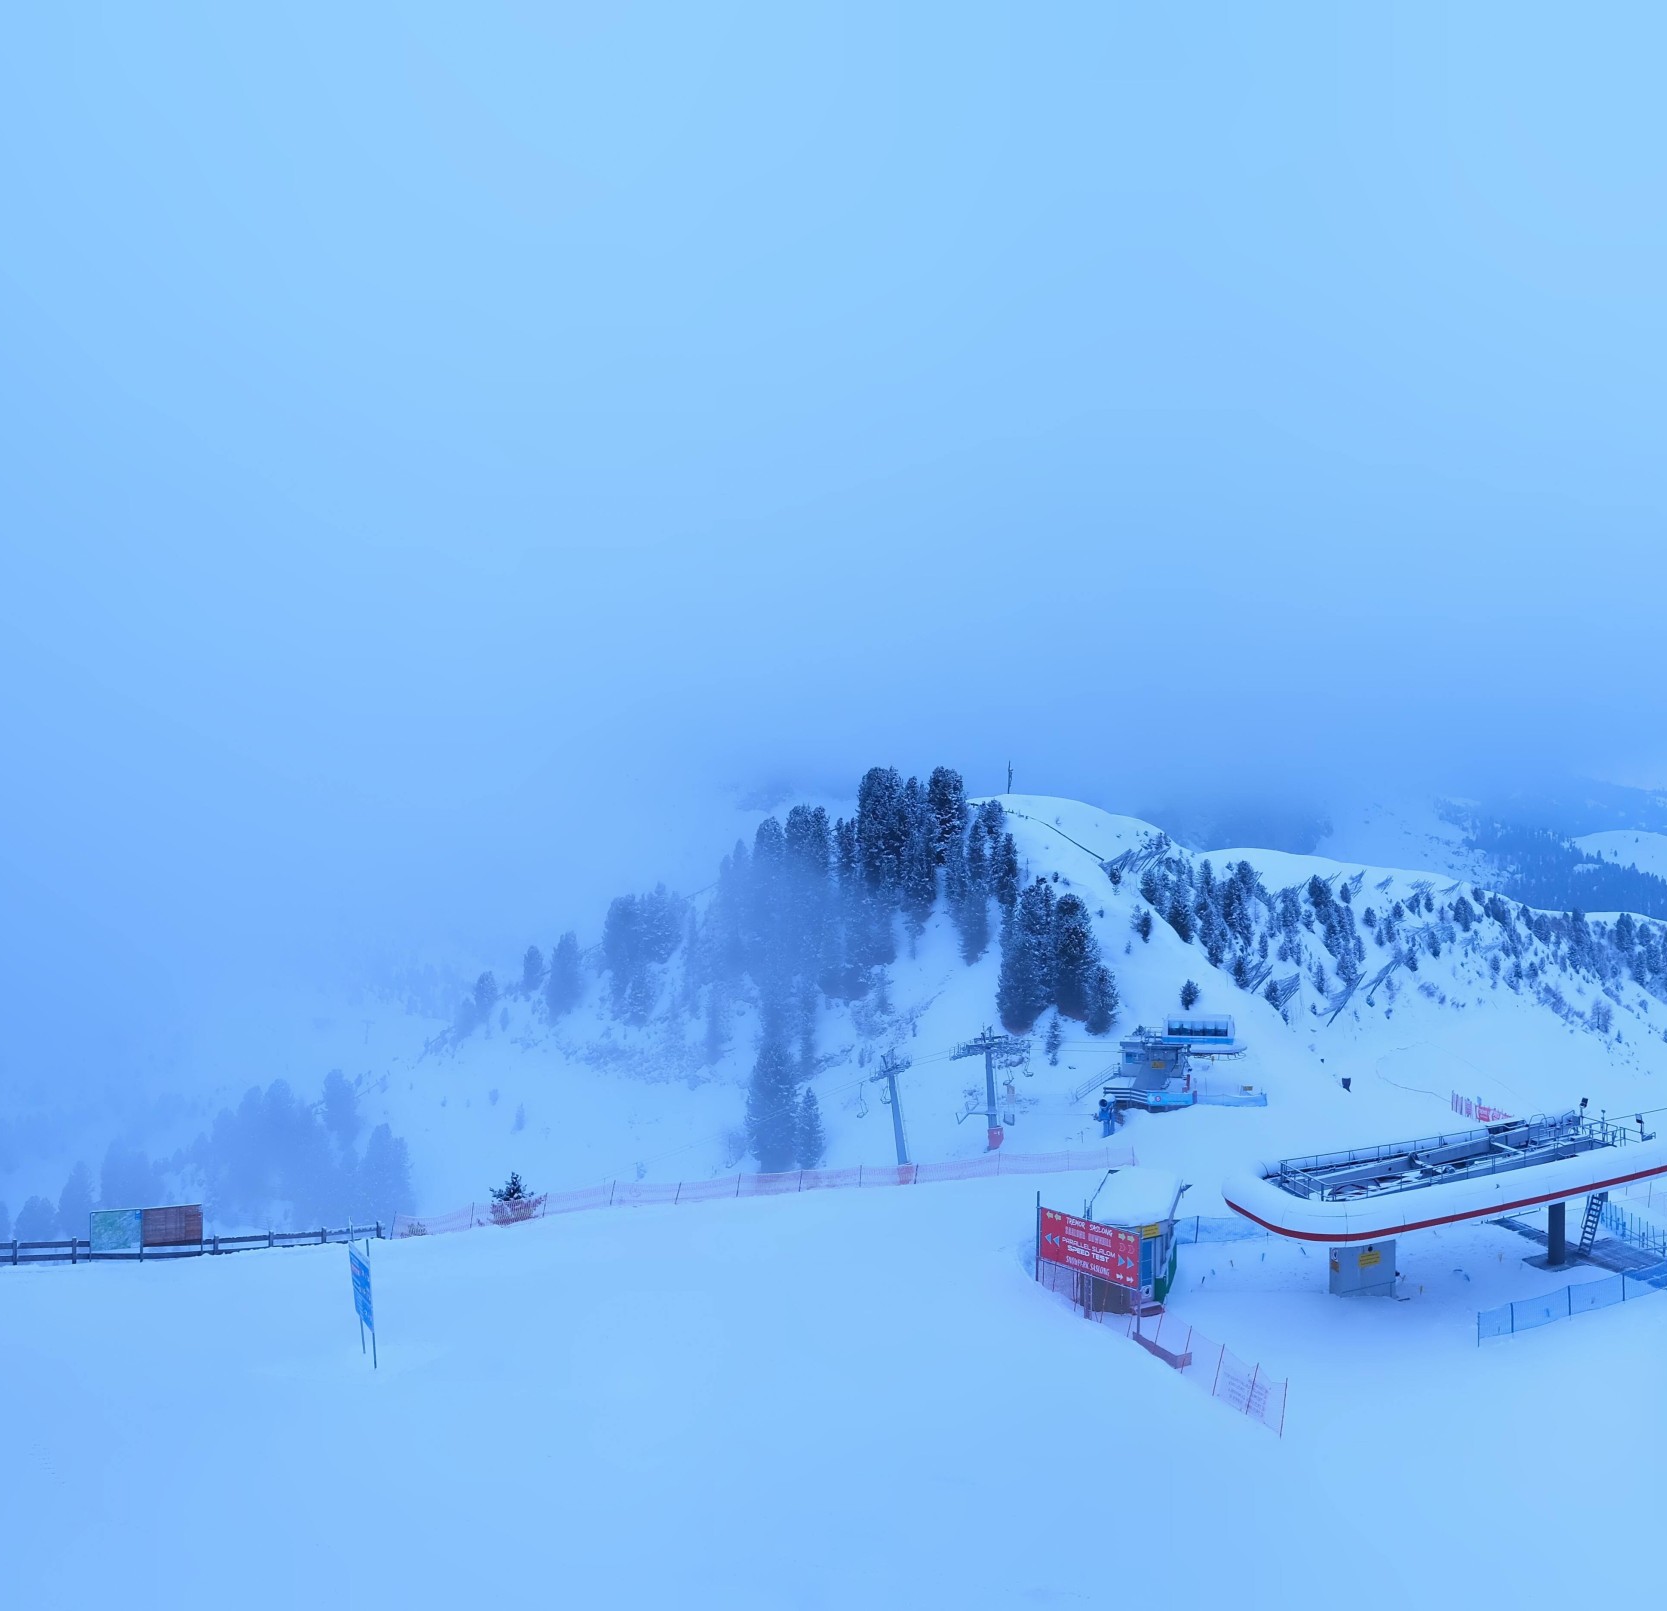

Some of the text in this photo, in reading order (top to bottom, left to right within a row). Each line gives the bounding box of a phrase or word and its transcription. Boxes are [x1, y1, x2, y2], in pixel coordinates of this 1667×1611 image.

[1089, 1224, 1113, 1237] SASLONG
[1062, 1237, 1116, 1258] PARALLEL SLALOM
[1067, 1245, 1109, 1262] SPEED TEST
[1090, 1263, 1110, 1276] SASLONG
